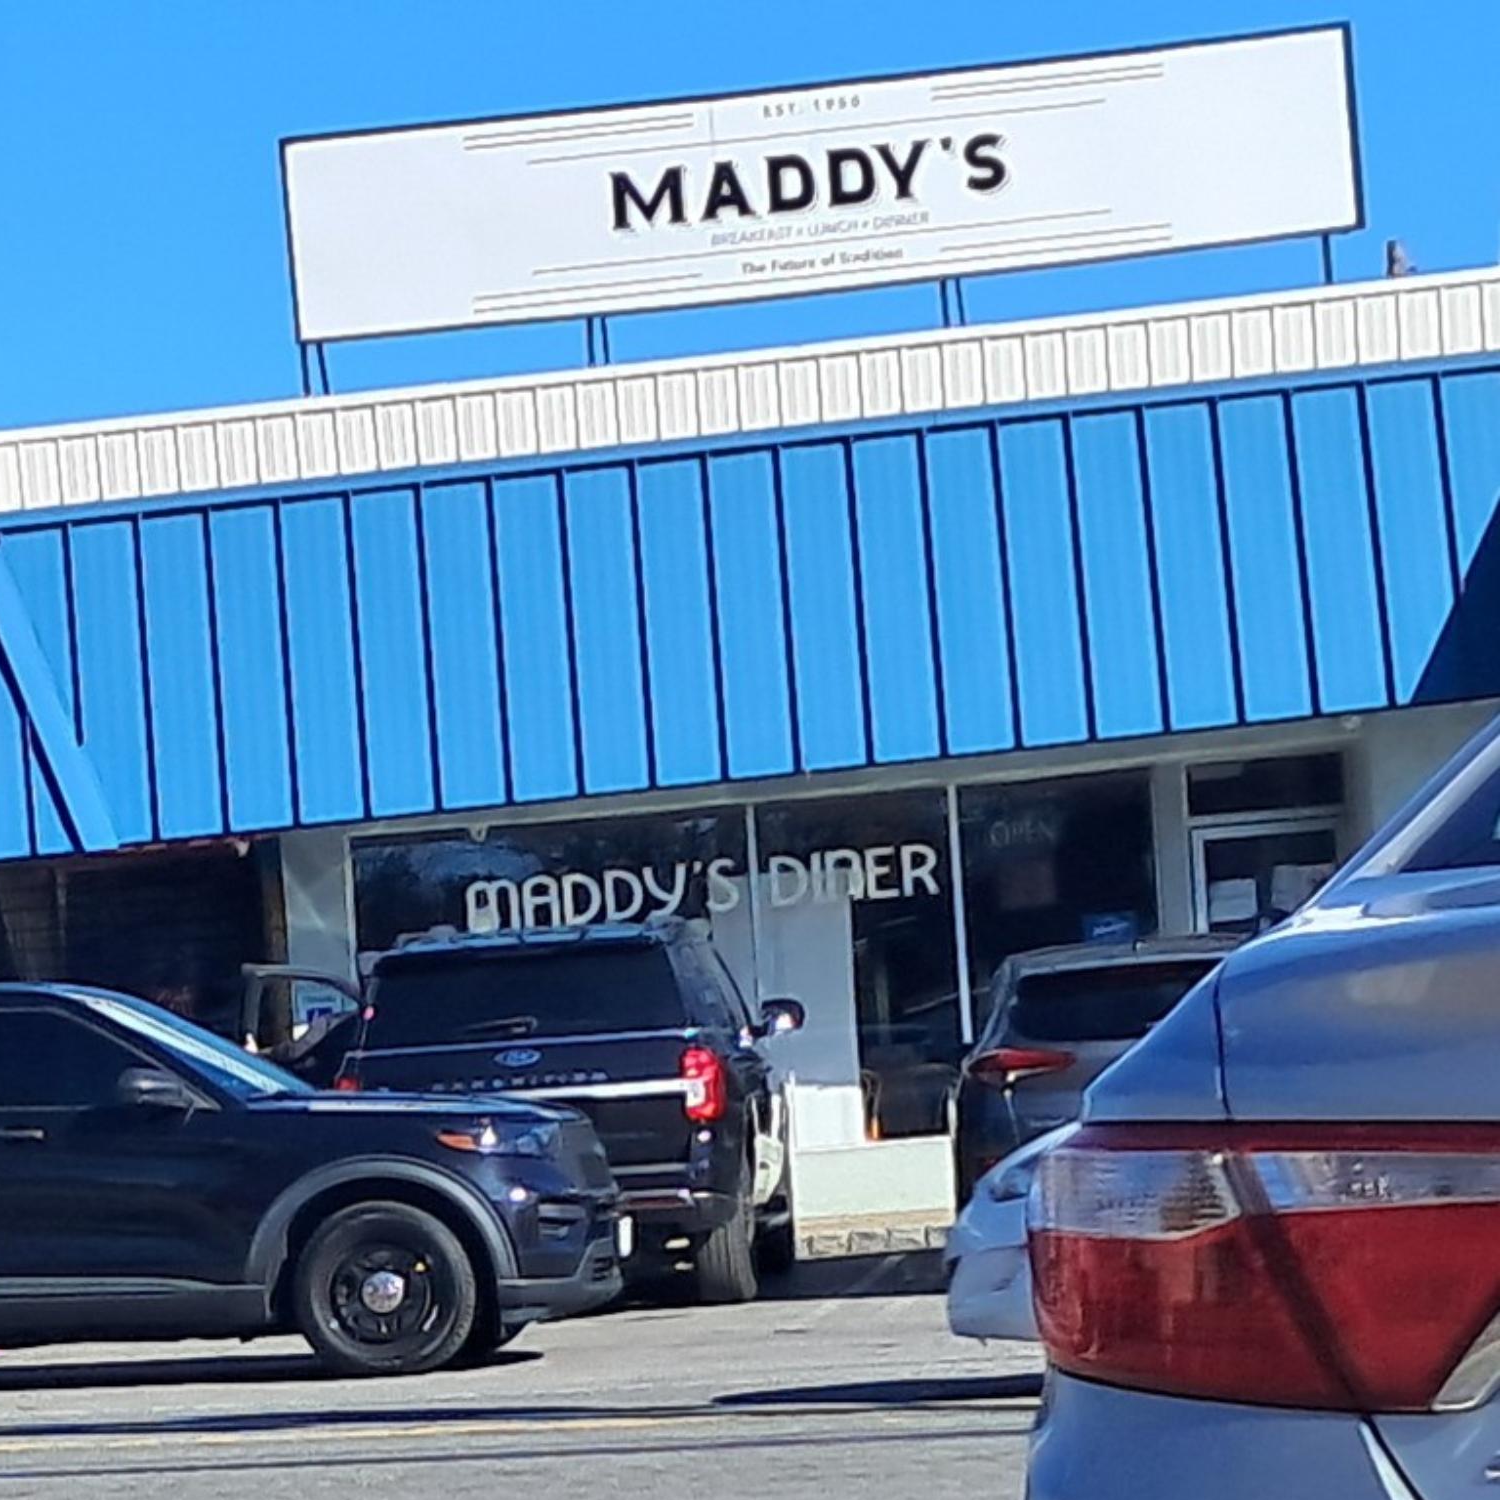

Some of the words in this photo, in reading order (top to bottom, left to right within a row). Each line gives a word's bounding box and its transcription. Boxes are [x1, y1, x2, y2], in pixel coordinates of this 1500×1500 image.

[609, 133, 1009, 231] MADDY'S
[710, 226, 793, 247] BREAKFAST
[872, 211, 930, 231] DINNER
[741, 262, 766, 275] The
[821, 253, 836, 266] of
[466, 858, 741, 934] MADDY'S
[768, 844, 940, 908] DINER
